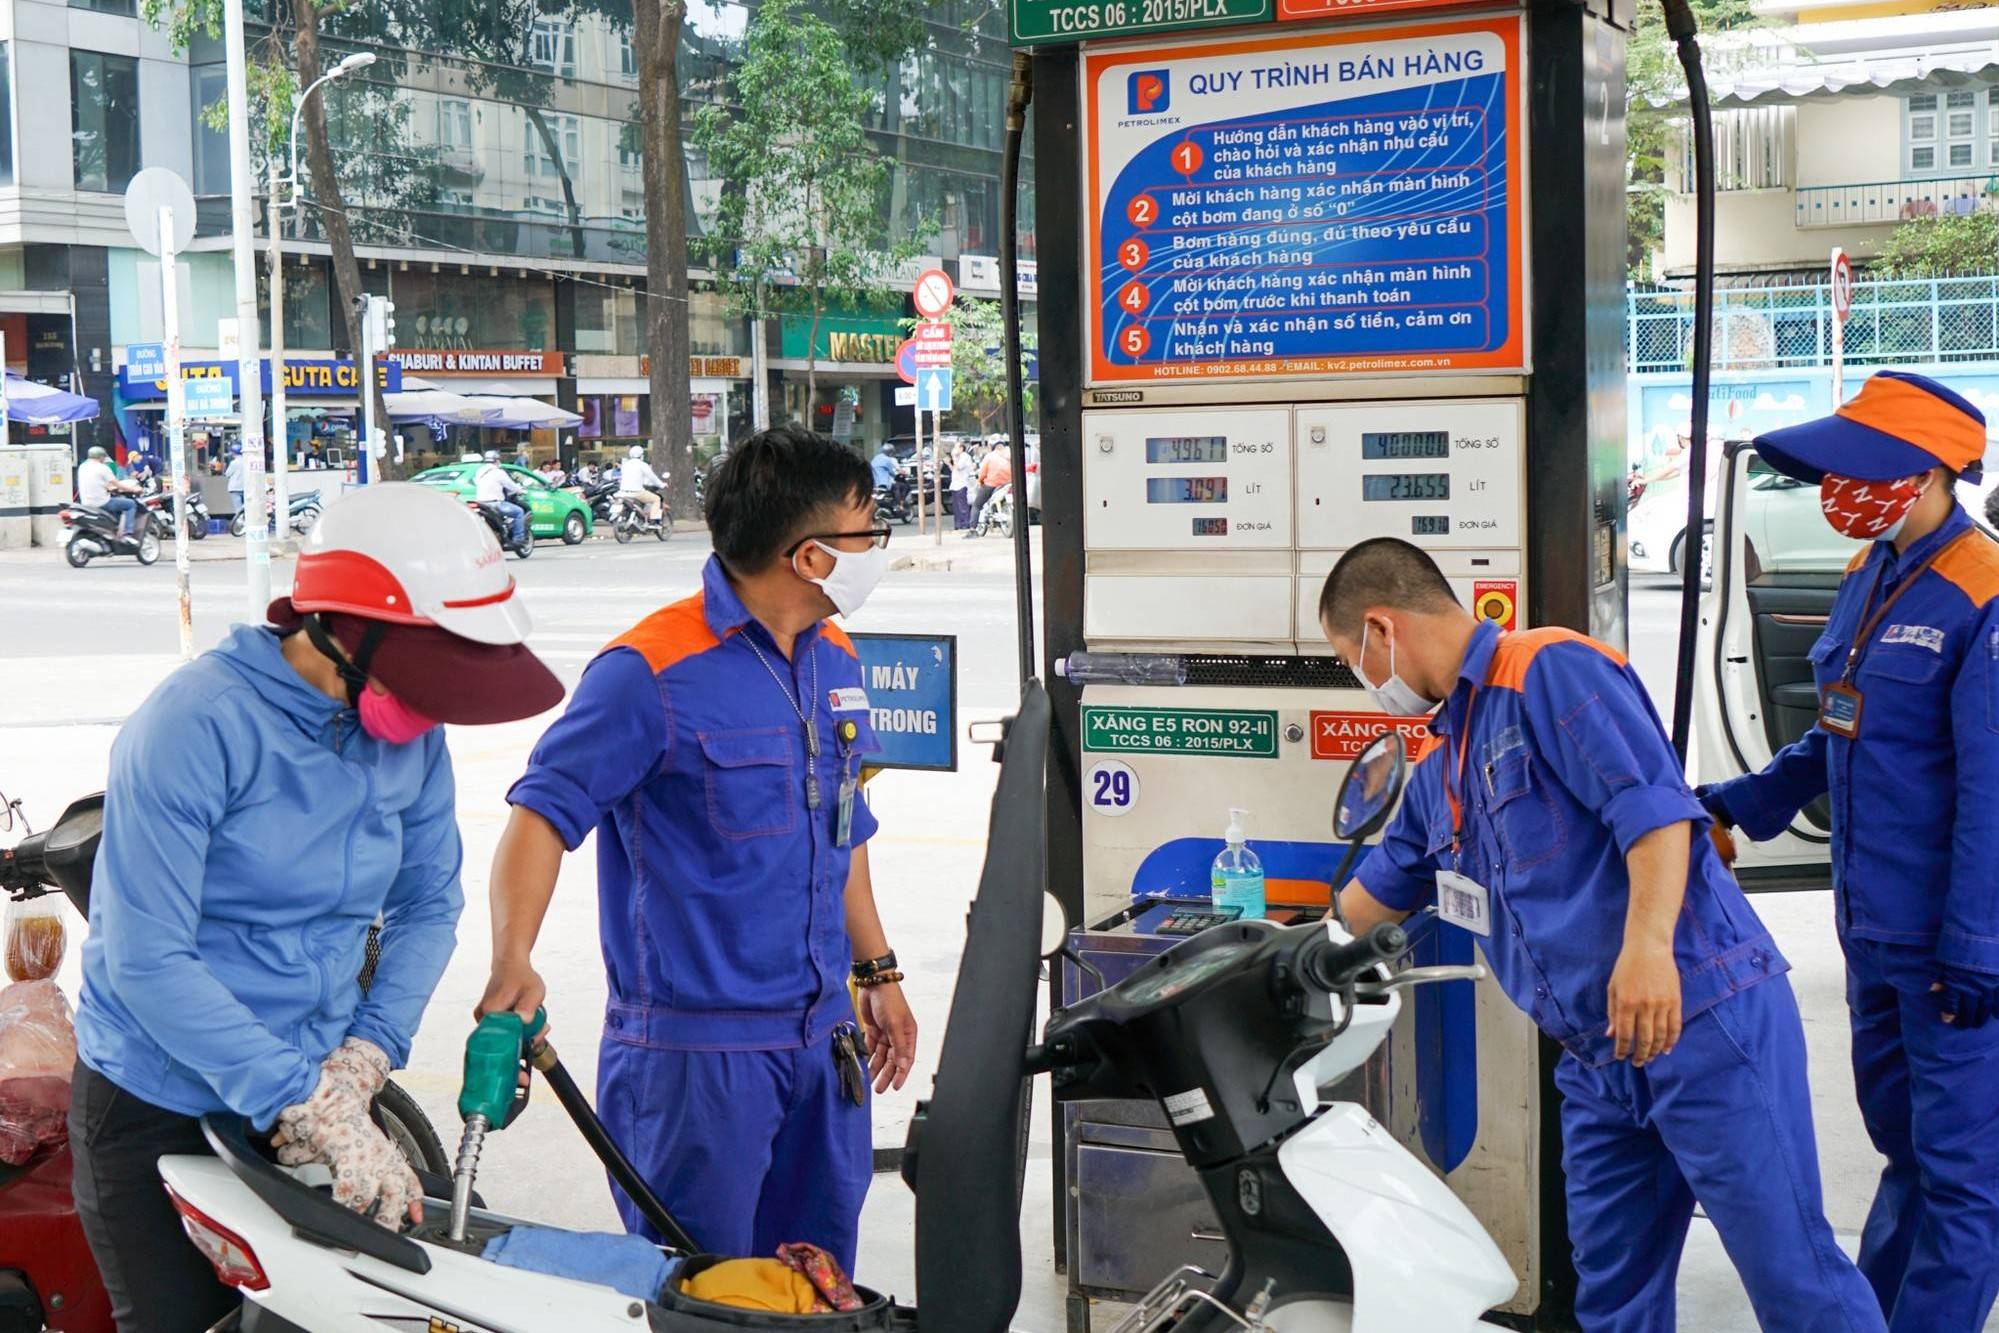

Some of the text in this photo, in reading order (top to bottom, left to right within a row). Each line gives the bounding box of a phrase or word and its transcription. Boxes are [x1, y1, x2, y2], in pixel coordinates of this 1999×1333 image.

[1049, 6, 1100, 32] TCCS
[1105, 2, 1126, 27] 06
[1143, 0, 1228, 23] 2015/PLX
[1189, 49, 1484, 95] QUY TRÌNH BÁN HÀNG
[1118, 117, 1181, 127] PETROLIMEX
[1214, 112, 1474, 145] Hướng dẫn khách hàng vào vị trí,
[1214, 131, 1449, 162] chào hỏi và xác nhận nhu cầu
[1180, 147, 1191, 169] 1
[1214, 160, 1336, 180] của khách hàng
[1172, 174, 1470, 206] Mời khách hàng xác nhận màn hình
[1134, 200, 1150, 222] 2
[1172, 212, 1198, 228] cột
[1203, 209, 1237, 225] bơm
[1242, 207, 1283, 223] đang
[1288, 203, 1298, 219] ở
[1303, 201, 1324, 218] số
[1173, 216, 1471, 250] Bơm hàng đúng, đủ theo yêu cầu
[1125, 244, 1141, 266] 3
[1173, 250, 1313, 270] của khách hàng
[1174, 265, 1471, 293] Mời khách hàng xác nhận màn hình
[1126, 286, 1141, 308] 4
[1174, 288, 1411, 314] cột bơm trước khi thanh toán
[1174, 321, 1218, 338] Nhận
[1223, 319, 1243, 334] và
[1249, 317, 1279, 332] xác
[1284, 316, 1328, 333] nhận
[1334, 313, 1356, 330] số
[1405, 310, 1443, 327] cảm
[1449, 312, 1472, 325] ơn
[1127, 330, 1142, 352] 5
[1174, 340, 1274, 356] khách hàng
[446, 354, 457, 370] &
[459, 354, 501, 370] KINTAN
[503, 355, 543, 371] BUFFET
[1154, 365, 1205, 376] HOTLINE:
[1207, 363, 1277, 374] 0902.68.44.88
[1286, 361, 1324, 371] EMAIL:
[1328, 358, 1451, 371] kv2.petrolimex.com.vn
[1094, 392, 1141, 402] TATSUNO
[1232, 441, 1274, 453] TỔNG SỐ
[1377, 432, 1448, 457] 400000
[1455, 436, 1499, 449] TỔNG SỐ
[1245, 482, 1262, 495] LÍT
[1469, 479, 1487, 491] LÍT
[1236, 520, 1272, 531] ĐƠN GIÁ
[1459, 519, 1497, 529] ĐƠN GIÁ
[872, 661, 919, 690] MÁY
[870, 708, 937, 734] TRONG
[1093, 714, 1268, 735] XĂNG E5 RON 92-II
[1322, 720, 1428, 739] XĂNG RO
[1110, 734, 1150, 747] TCCS
[1154, 735, 1171, 747] 06
[1185, 737, 1253, 750] 2015/PLX
[1094, 770, 1130, 806] 29
